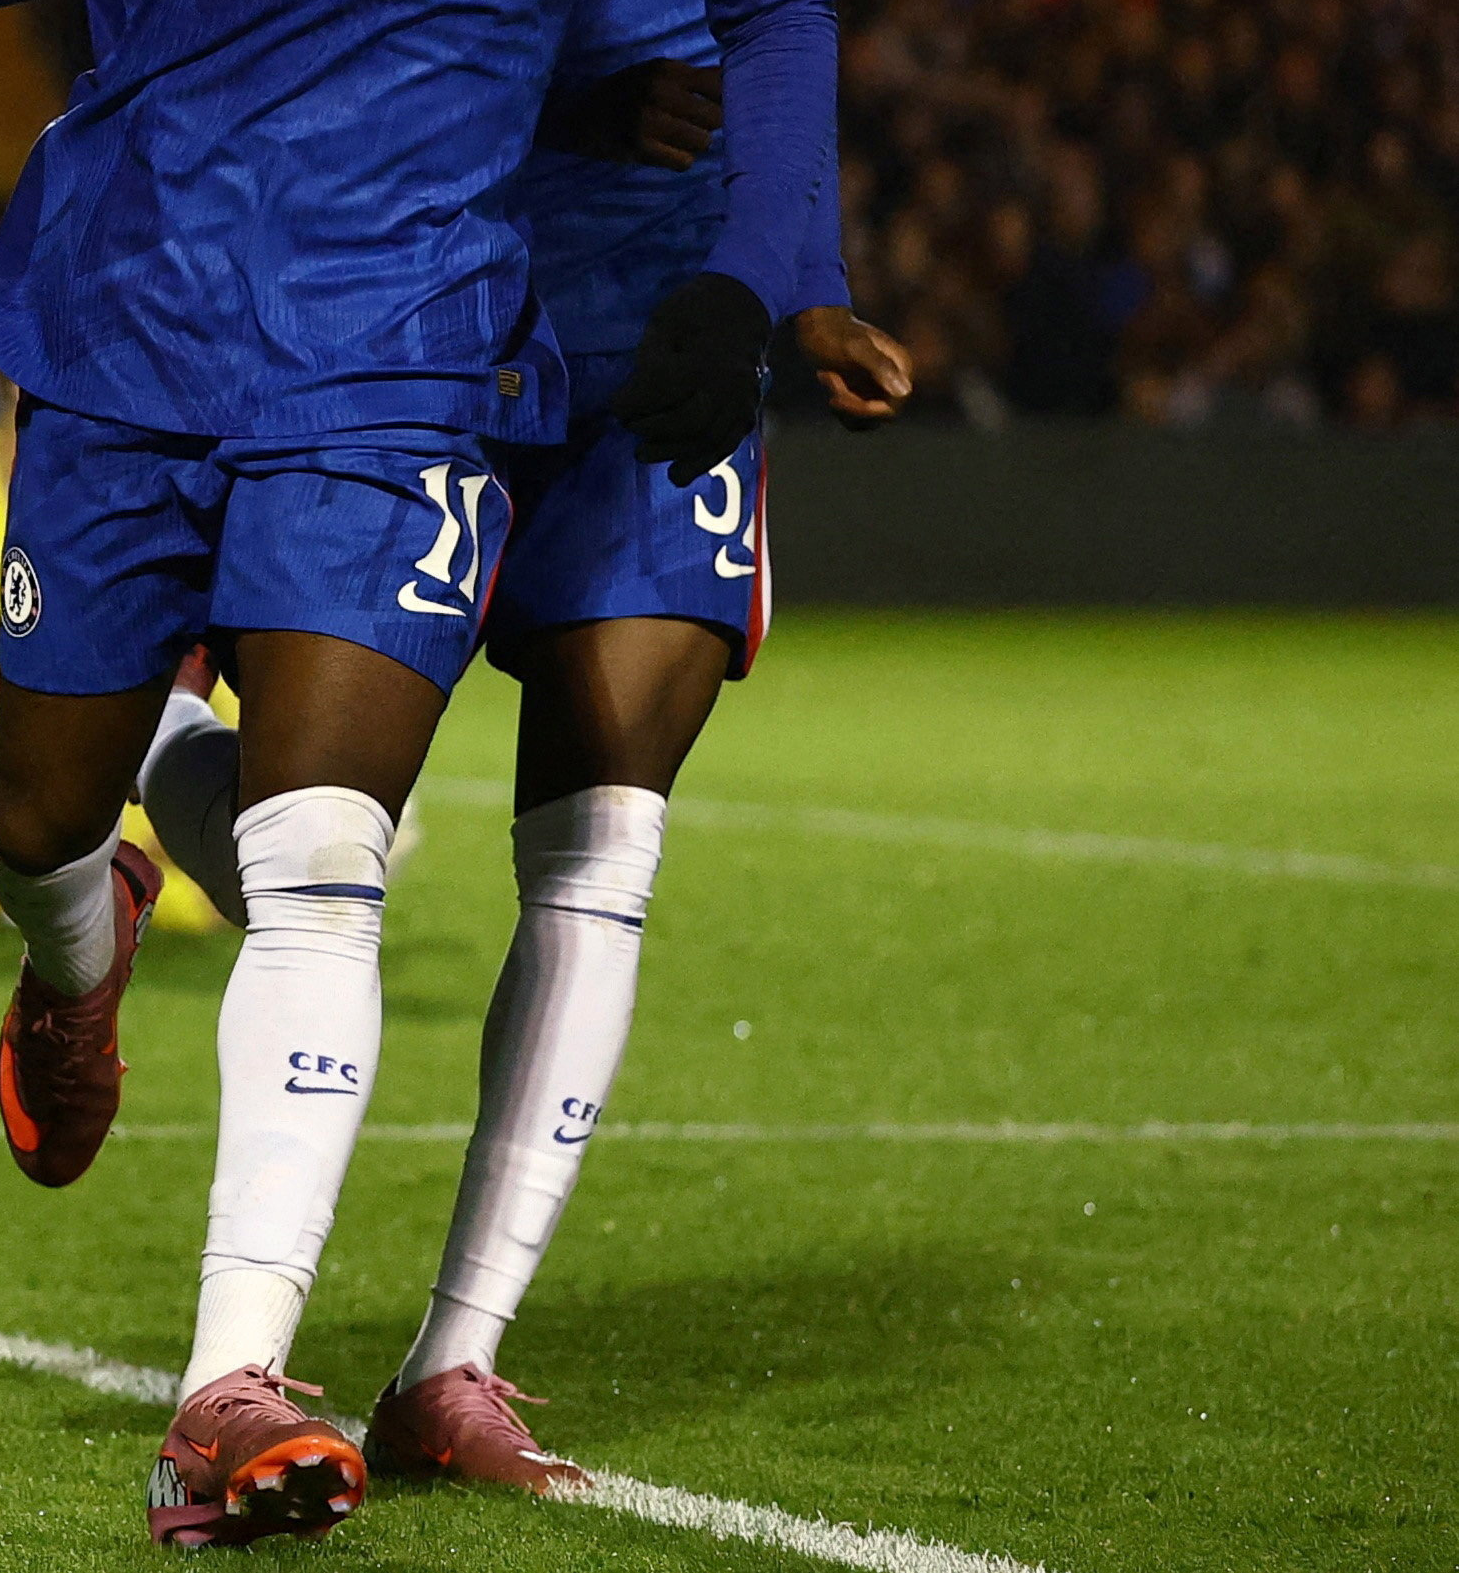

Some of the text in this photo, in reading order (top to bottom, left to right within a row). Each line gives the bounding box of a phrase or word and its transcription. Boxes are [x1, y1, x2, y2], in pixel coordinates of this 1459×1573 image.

[415, 463, 489, 604] 11
[694, 444, 755, 553] 3
[289, 1051, 358, 1085] CFC
